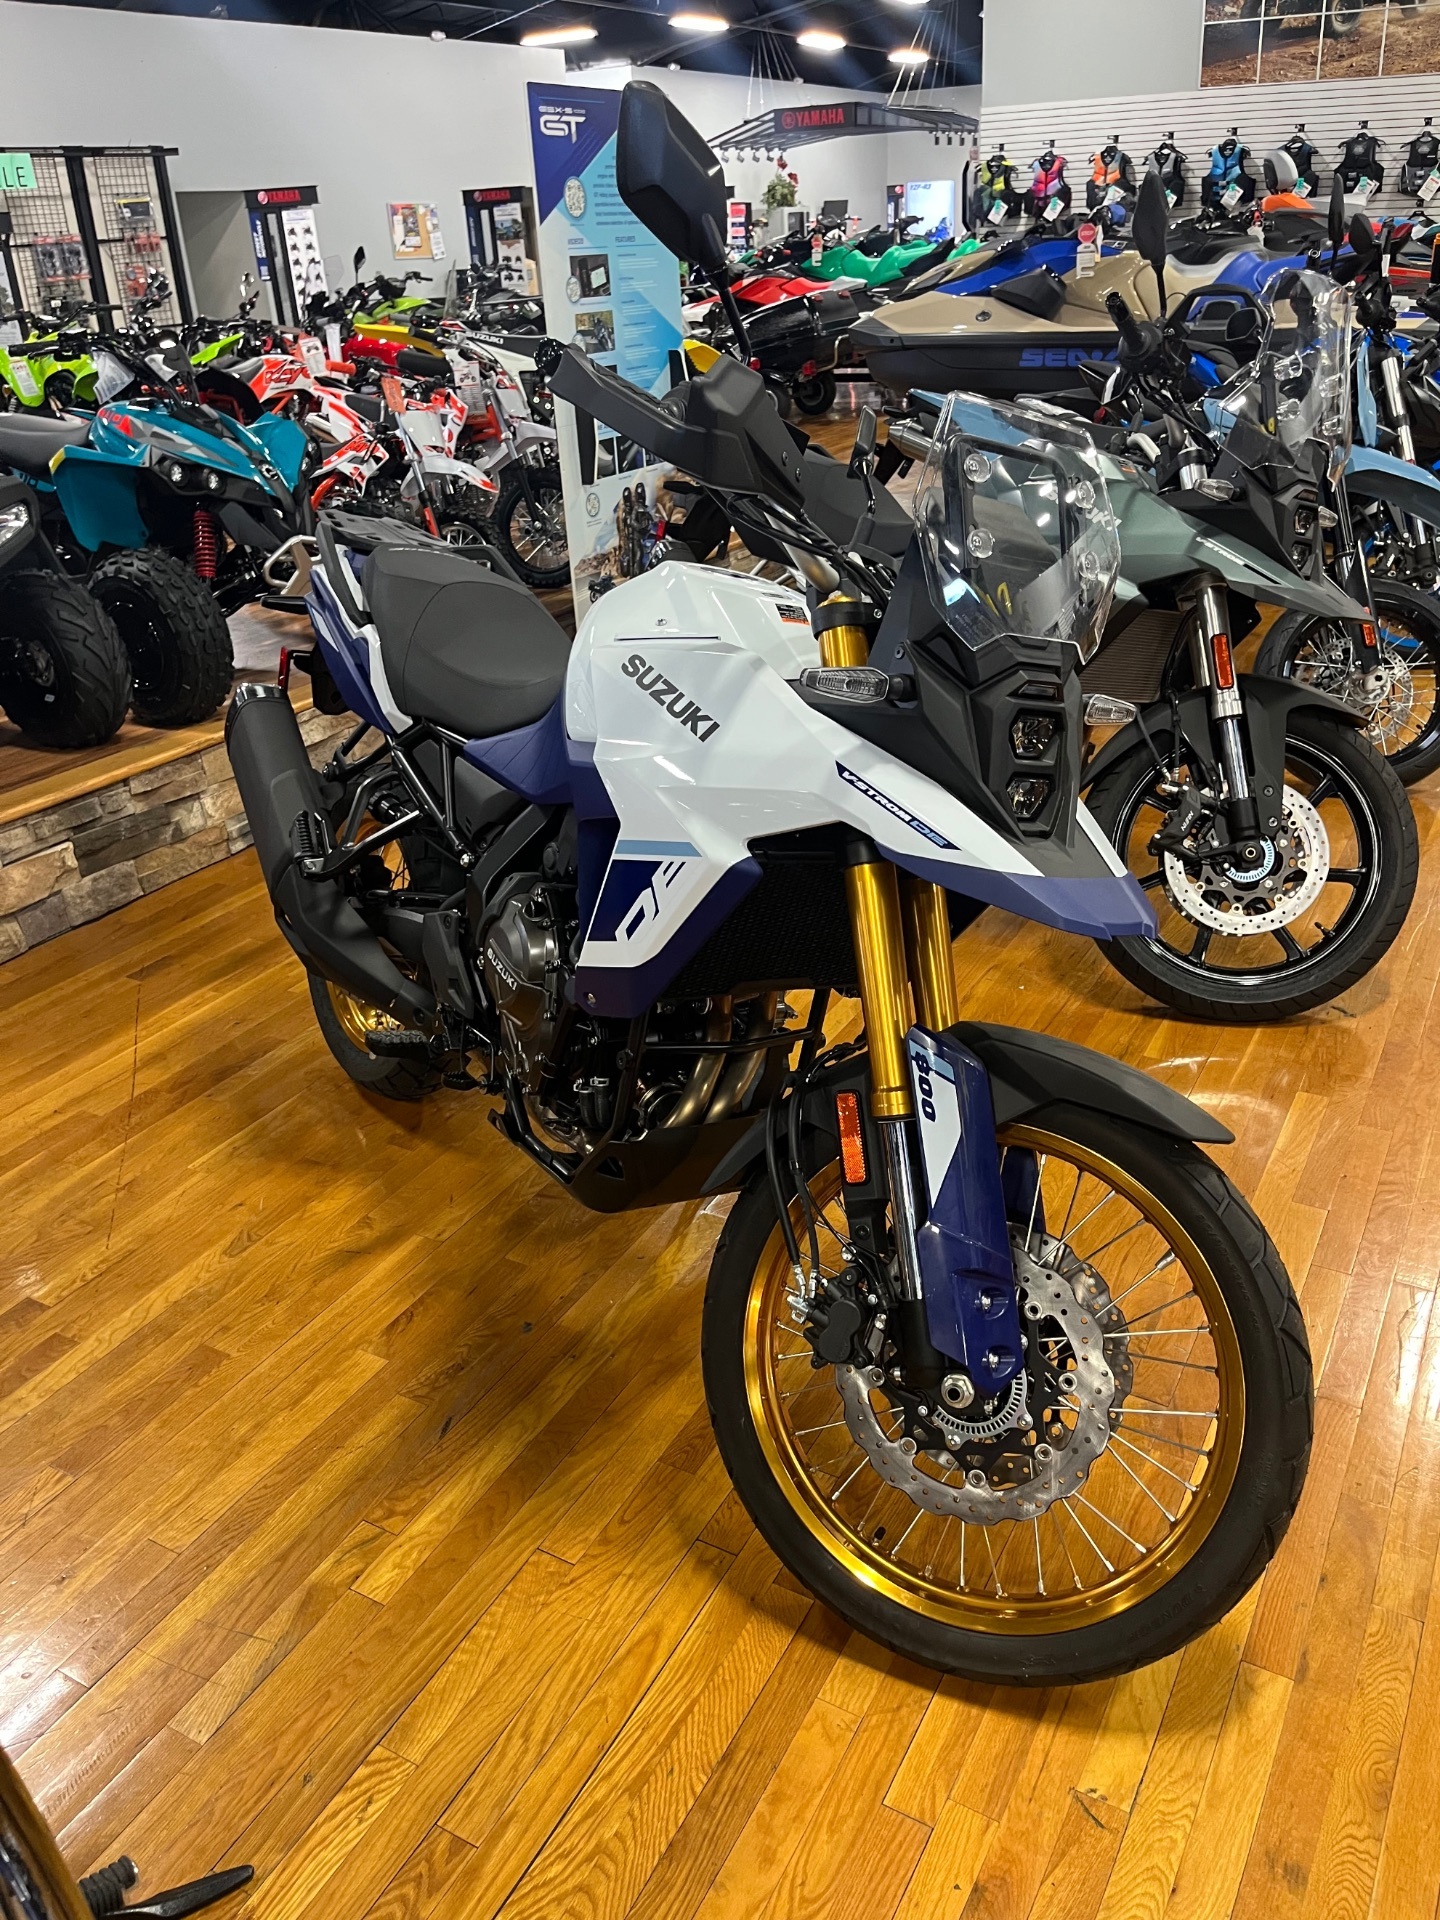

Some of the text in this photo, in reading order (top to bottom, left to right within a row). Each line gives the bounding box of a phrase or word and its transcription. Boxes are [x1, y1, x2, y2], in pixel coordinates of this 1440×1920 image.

[796, 108, 844, 127] YAMAHA
[0, 167, 28, 188] LE
[472, 331, 504, 345] UZUKI
[1019, 348, 1121, 368] SEA-
[621, 654, 721, 743] SUZUKI
[841, 770, 913, 823] V-STROM
[487, 947, 518, 991] SUZUKI
[913, 1050, 937, 1123] 800
